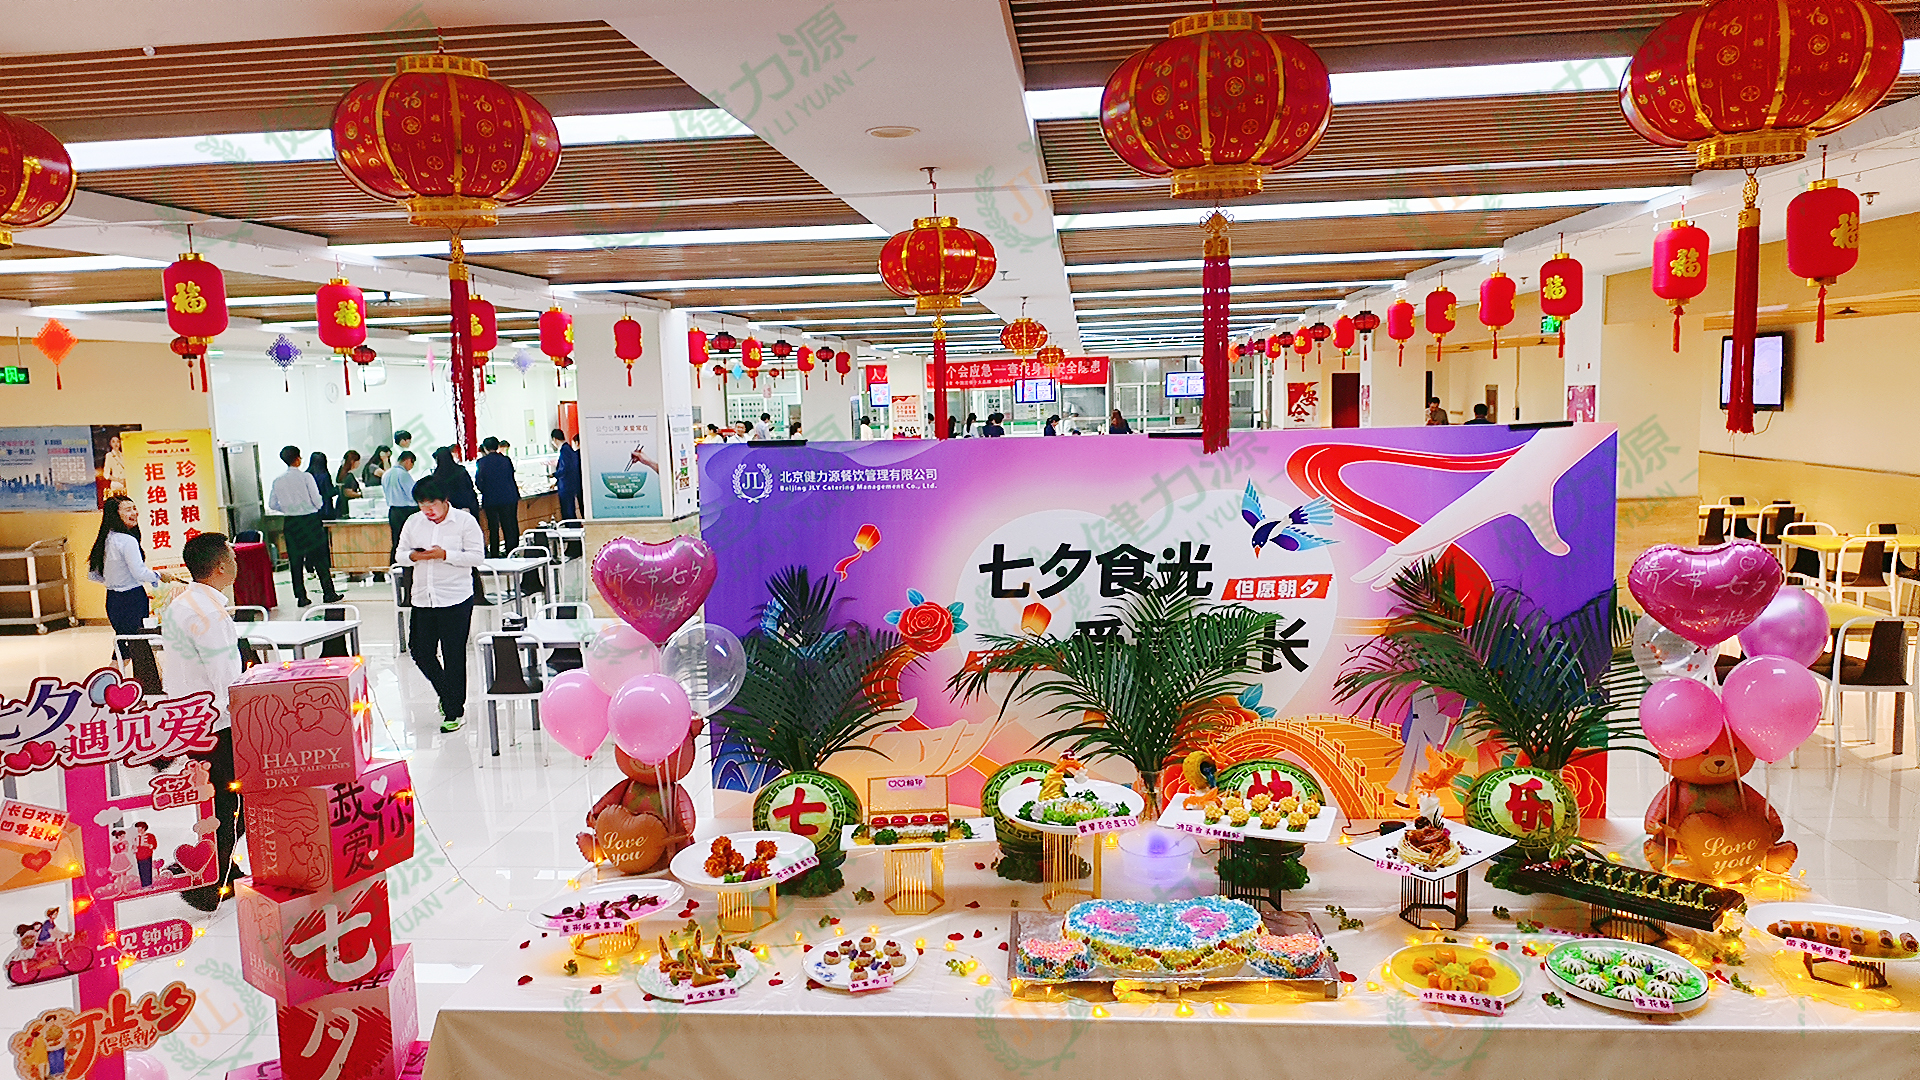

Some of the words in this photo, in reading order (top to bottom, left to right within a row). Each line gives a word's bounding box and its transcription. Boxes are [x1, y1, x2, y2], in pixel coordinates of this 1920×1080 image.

[1830, 212, 1860, 249] 福
[1670, 248, 1701, 278] 福
[172, 281, 207, 313] 福
[1543, 275, 1567, 300] 福
[334, 299, 361, 328] 福
[742, 472, 764, 490] JL
[780, 469, 938, 483] 北京健力源餐饮管理有限公司
[780, 484, 807, 493] Beijing
[822, 483, 855, 492] Catering
[857, 483, 904, 491] Management
[922, 482, 938, 490] Ltd.
[144, 462, 172, 549] 拒绝浪费
[176, 460, 202, 543] 珍惜粮食
[978, 541, 1213, 600] 七夕食光
[1234, 578, 1321, 600] 但愿朝夕
[64, 698, 214, 760] 遇见爱
[262, 747, 342, 770] HAPPY
[265, 767, 299, 776] CHINESE
[300, 762, 351, 773] VALENTINE'S
[163, 779, 187, 792] 七夕
[266, 776, 300, 789] DAY
[772, 786, 828, 837] 七
[1505, 777, 1554, 832] 乐
[263, 808, 279, 876] HAPPY
[603, 831, 649, 850] Love
[1702, 837, 1760, 858] Love
[612, 851, 645, 867] you
[1712, 854, 1756, 875] you
[97, 923, 184, 951] 一见钟情
[154, 941, 184, 957] YOU
[290, 904, 378, 983] 七
[250, 954, 281, 982] HAPPY
[300, 1007, 359, 1080] 夕
